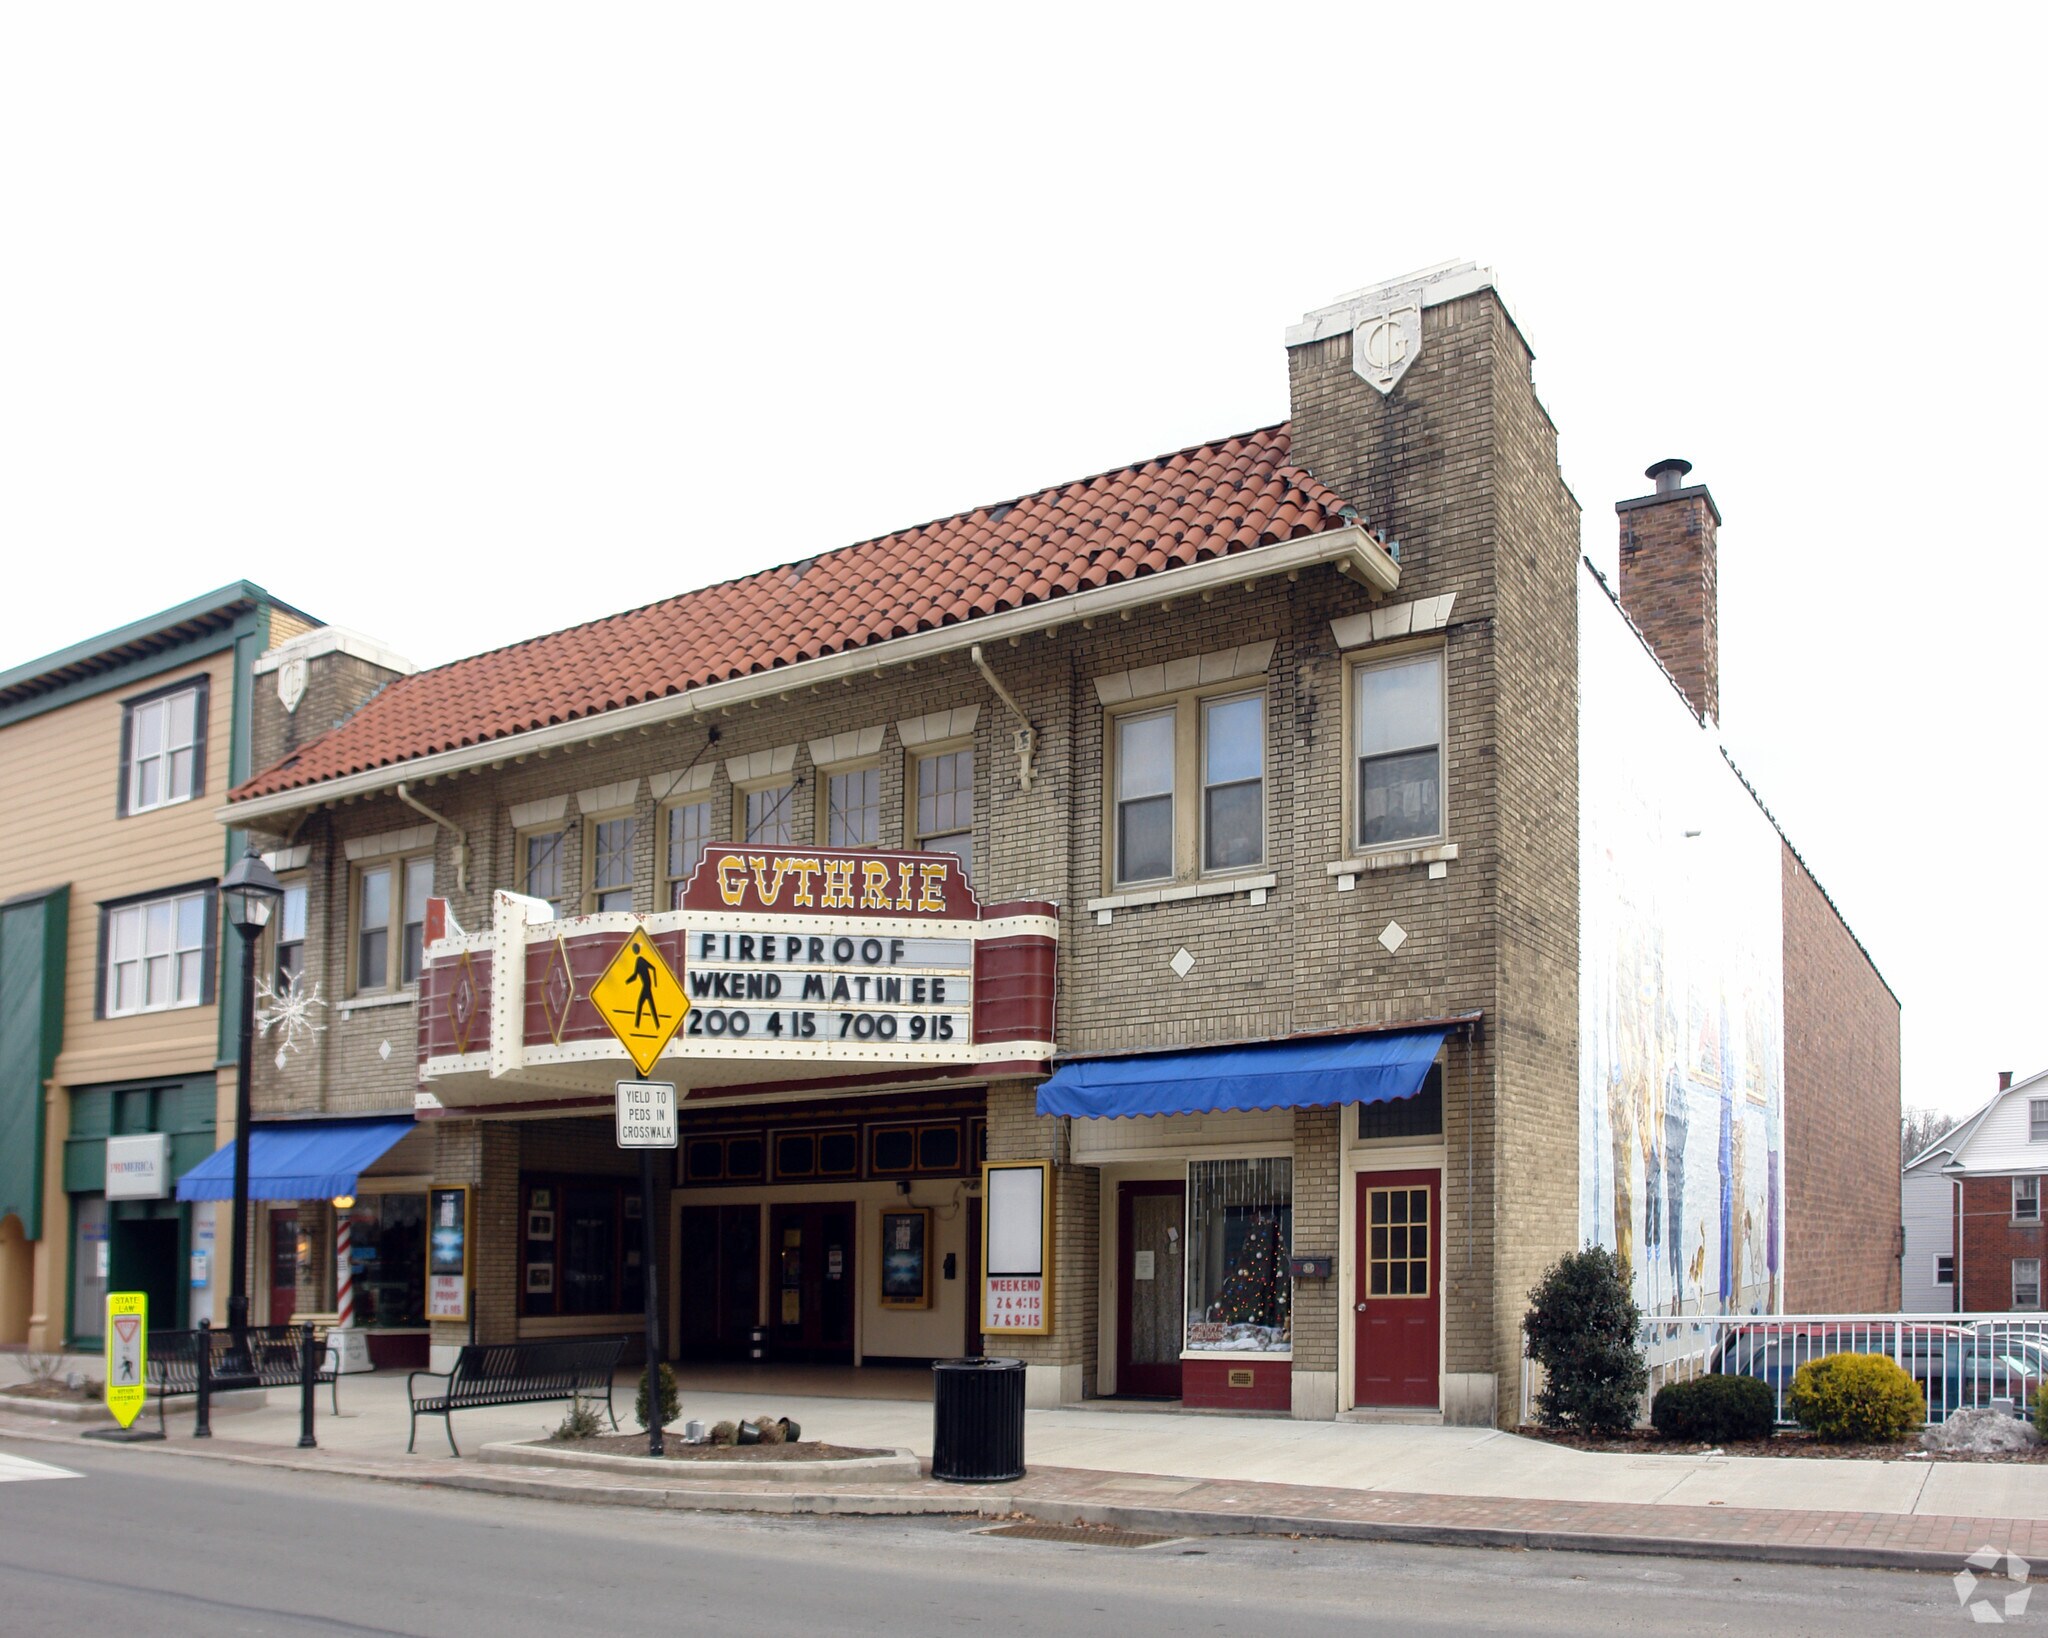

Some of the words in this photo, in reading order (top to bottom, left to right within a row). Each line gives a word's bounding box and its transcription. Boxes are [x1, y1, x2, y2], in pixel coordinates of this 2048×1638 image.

[701, 933, 905, 965] FIREPROOF
[690, 971, 782, 999] WKEND
[802, 974, 945, 1003] MATINEE
[687, 1009, 750, 1037] 200
[767, 1011, 816, 1038] 415
[840, 1013, 898, 1040] 700
[909, 1015, 954, 1041] 915
[626, 1090, 650, 1104] YIELD
[656, 1091, 667, 1105] TO
[629, 1108, 651, 1121] PEDS
[656, 1109, 665, 1121] IN
[623, 1126, 672, 1139] CROSSWALK
[110, 1161, 154, 1173] PRIMERICA
[991, 1279, 1041, 1292] WEEKEND
[115, 1296, 139, 1304] STATE
[996, 1297, 1003, 1309] 2
[1015, 1296, 1040, 1309] 4:15
[993, 1313, 999, 1326] 7
[1014, 1313, 1040, 1327] 9:15
